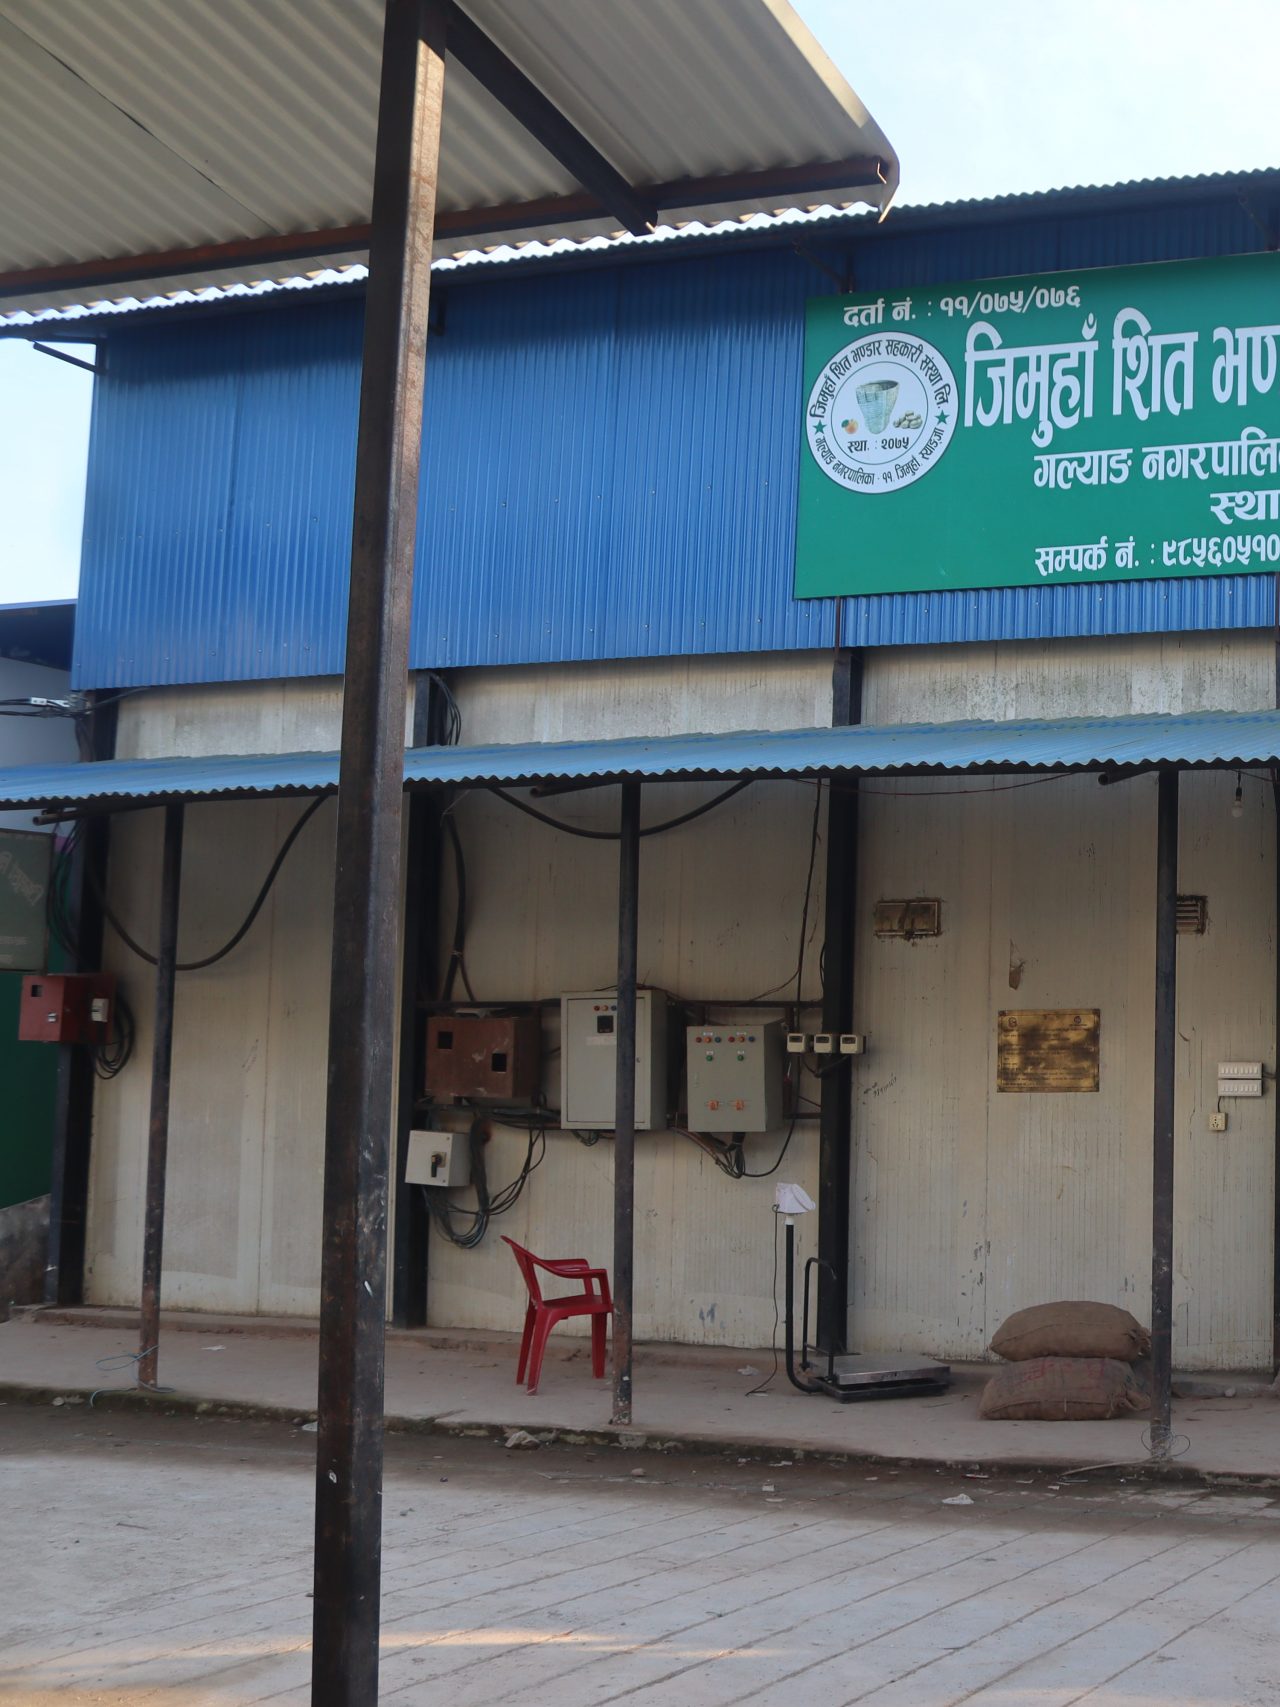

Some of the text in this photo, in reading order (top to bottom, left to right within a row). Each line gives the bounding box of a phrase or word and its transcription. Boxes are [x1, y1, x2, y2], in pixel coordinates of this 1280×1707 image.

[843, 298, 884, 327] दर्ता
[892, 297, 916, 321] नं.
[939, 284, 1081, 320] ११/०७५/०७६
[829, 354, 853, 380] शित
[850, 339, 883, 363] भण्डार
[885, 339, 924, 364] सहकारी
[964, 312, 1100, 448] जिमुहाँ
[1111, 307, 1199, 421] शित
[881, 436, 910, 450] २०७५
[1033, 447, 1134, 490] गल्याङ
[1034, 535, 1109, 577] सम्पर्क
